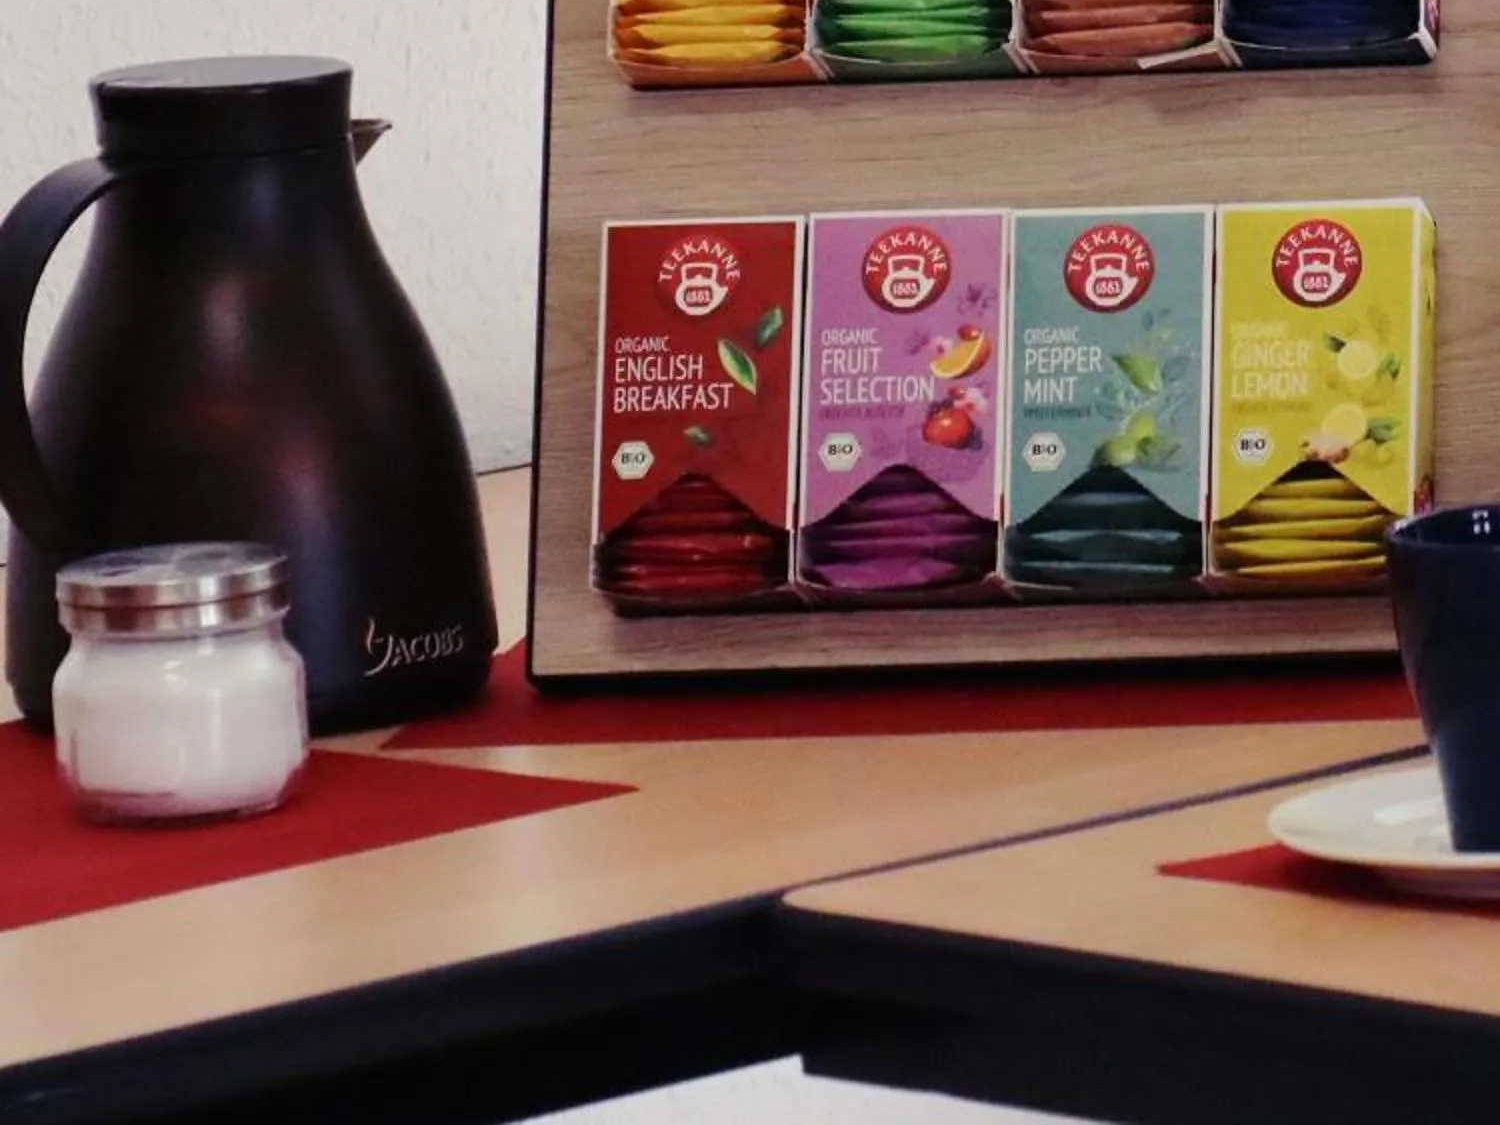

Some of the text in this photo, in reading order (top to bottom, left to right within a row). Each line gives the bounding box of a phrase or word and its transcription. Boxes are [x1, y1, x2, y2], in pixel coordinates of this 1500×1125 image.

[865, 232, 947, 275] TEEKANNE
[1067, 229, 1150, 273] TEEKANNE
[1276, 224, 1358, 268] TEEKANNE
[659, 239, 741, 283] TEEKANNE
[615, 336, 670, 354] ORGANIC
[821, 328, 879, 346] ORGANIC
[1024, 327, 1079, 345] ORGANIC
[821, 347, 882, 376] FRUIT
[1024, 346, 1103, 374] PEPPER
[1231, 339, 1312, 368] GINGER
[615, 354, 703, 383] ENGLISH
[613, 383, 734, 413] BREAKFAST
[820, 375, 935, 405] SELECTION
[1023, 376, 1078, 404] MINT
[1231, 370, 1309, 399] LEMON
